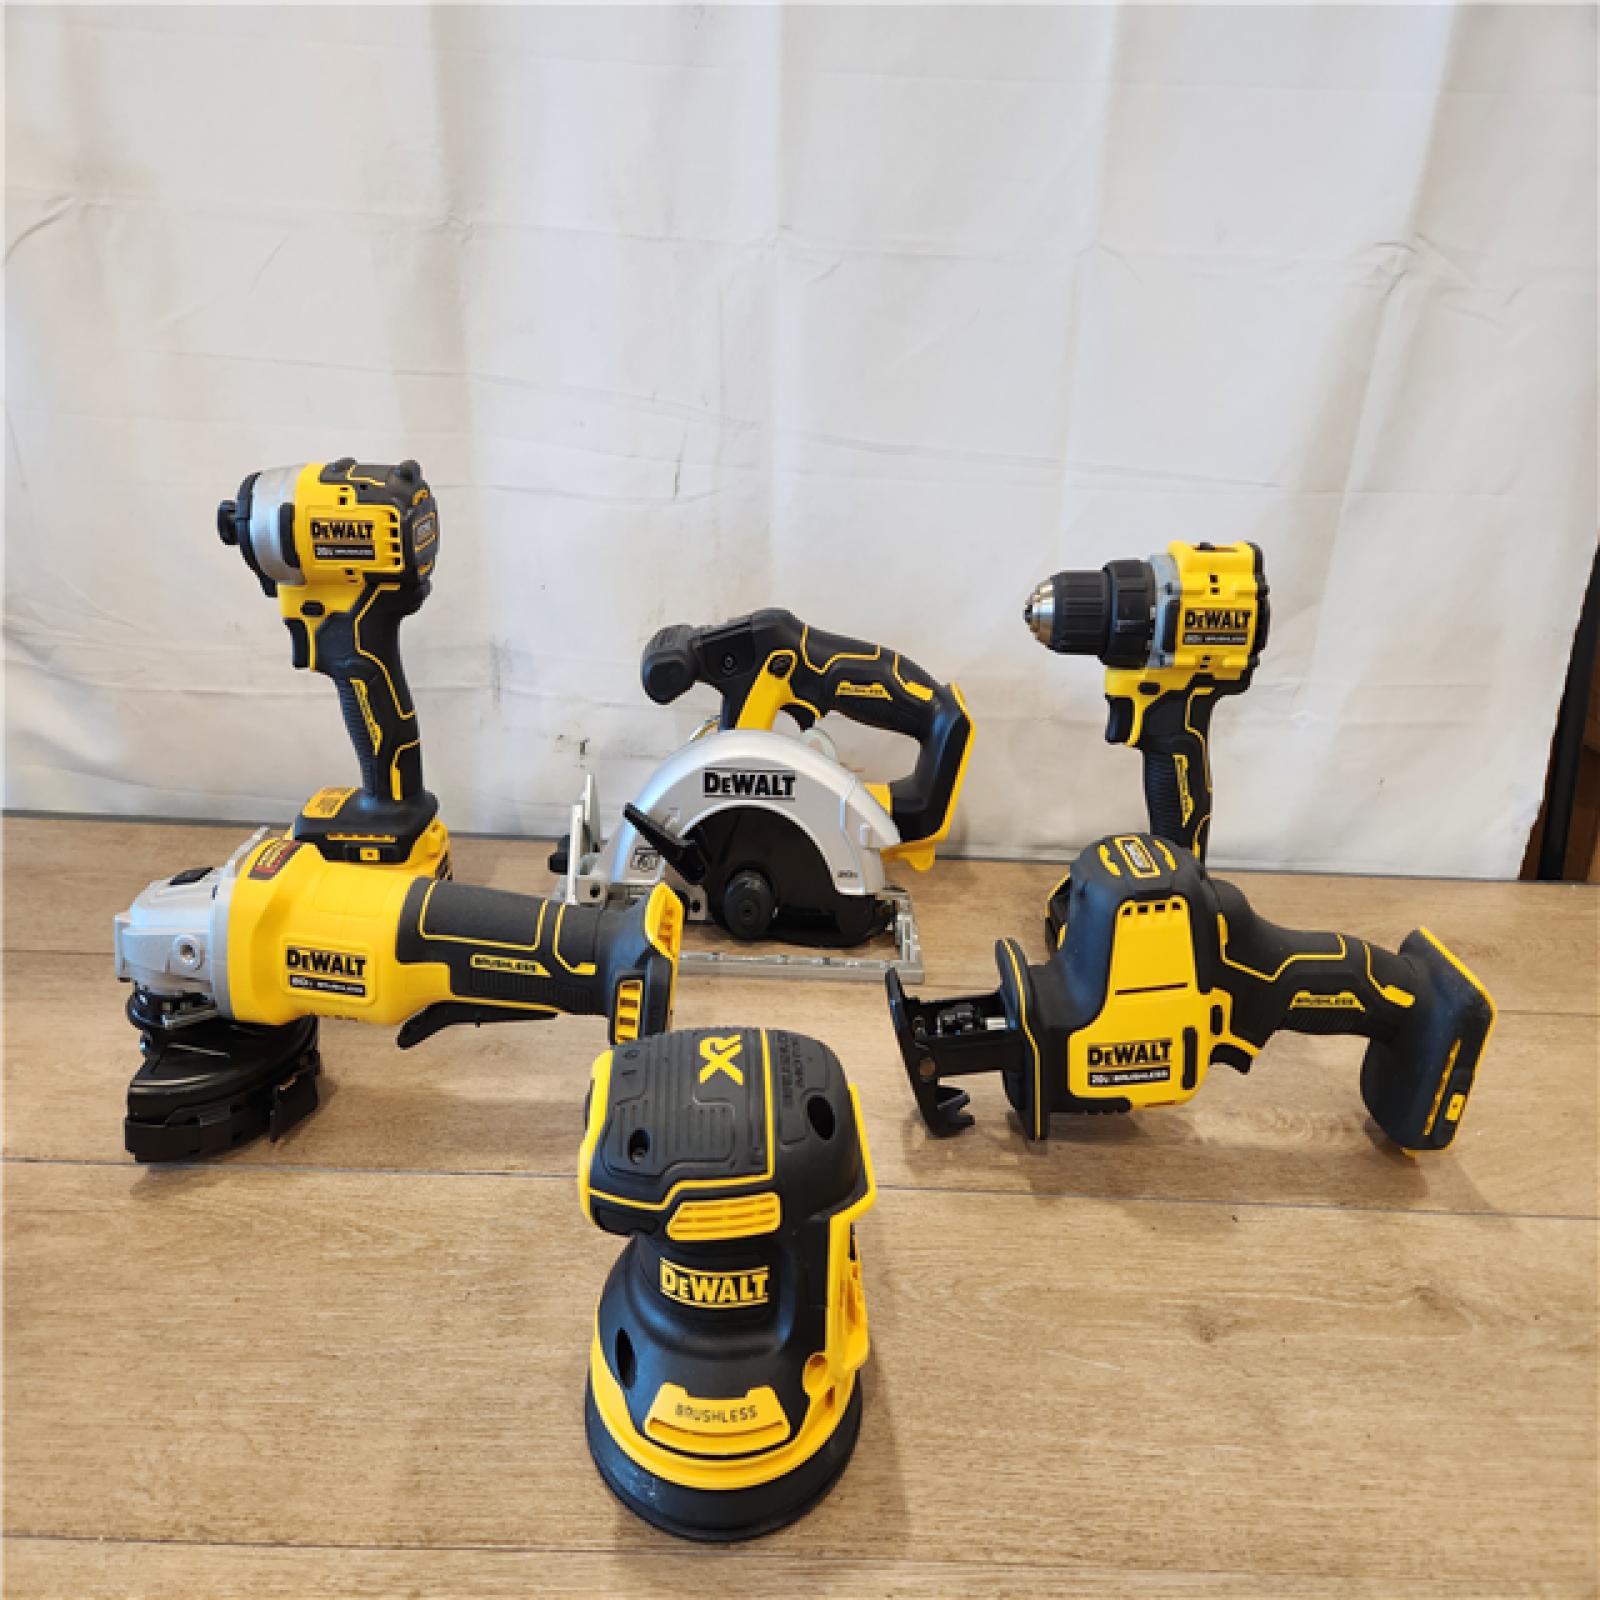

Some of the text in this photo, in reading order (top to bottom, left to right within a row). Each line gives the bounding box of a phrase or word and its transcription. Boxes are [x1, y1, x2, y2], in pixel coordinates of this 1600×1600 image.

[310, 521, 374, 538] DEWALT
[1184, 611, 1251, 628] DEWALT
[704, 772, 796, 796] DEWALT
[286, 949, 366, 976] DEWALT
[1089, 1041, 1172, 1066] DEWALT
[660, 1262, 770, 1304] DEWALT
[674, 1402, 759, 1424] BRUSHLESS
